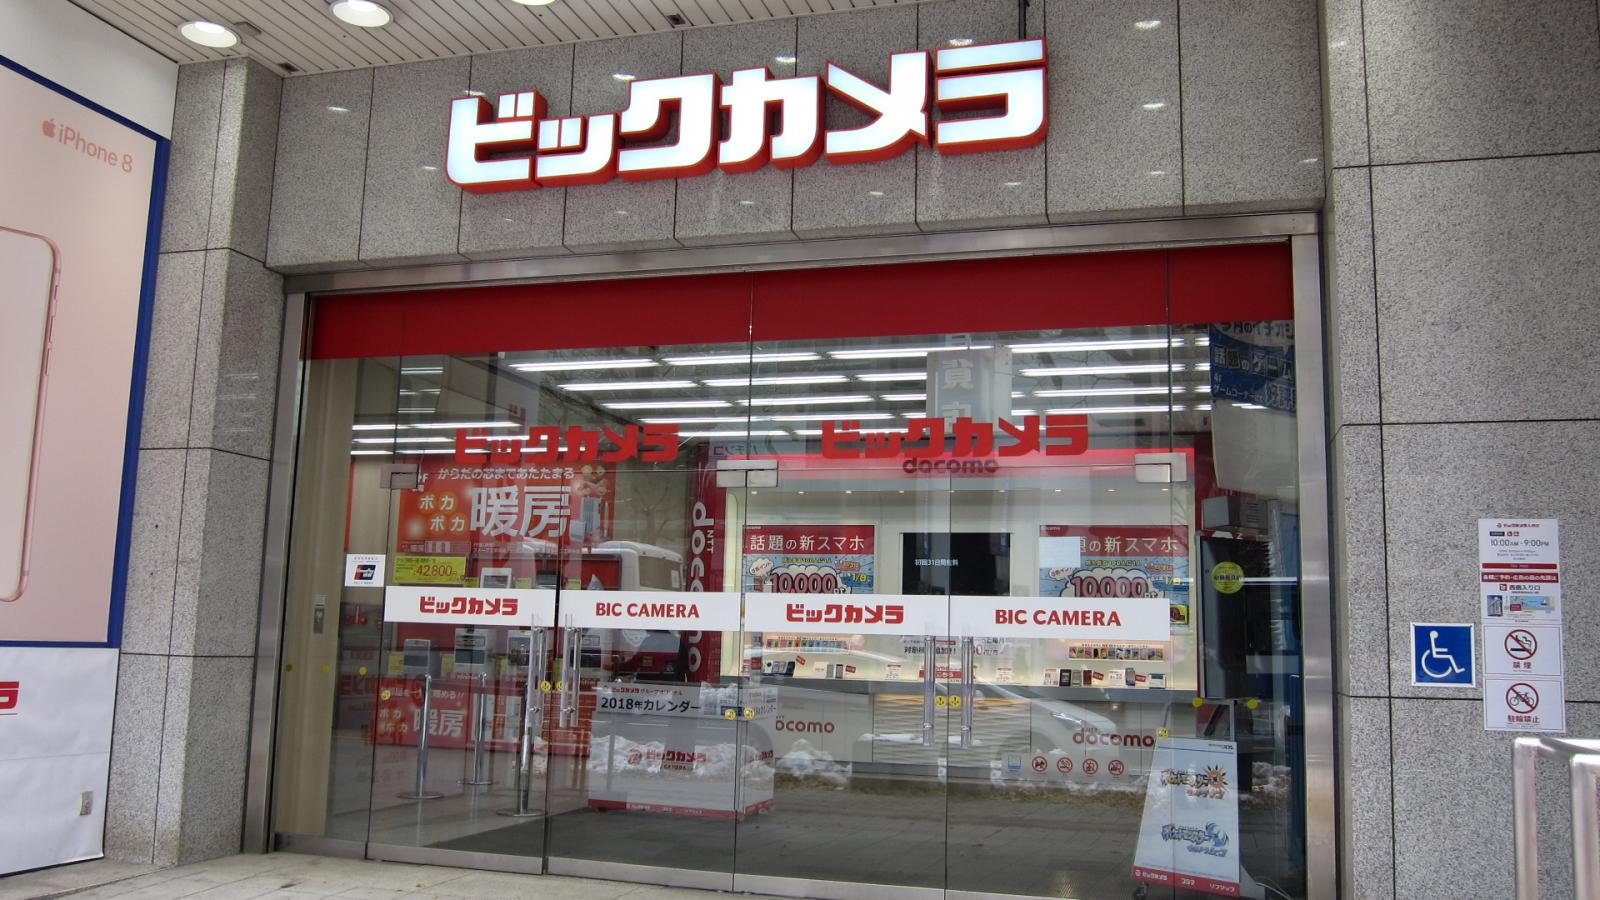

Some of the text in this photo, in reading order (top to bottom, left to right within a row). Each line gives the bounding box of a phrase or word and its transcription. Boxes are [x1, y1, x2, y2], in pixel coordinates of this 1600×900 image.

[445, 38, 1049, 193] ビックカメラ
[59, 124, 133, 173] iPhone 8
[455, 424, 680, 464] ビックカメラ
[821, 414, 1089, 459] ビックカメラ
[438, 467, 575, 480] からだの芯まであたたまる
[903, 458, 998, 473] docomo
[470, 485, 571, 537] 暖房
[750, 535, 865, 551] 話題の新スマホ
[1080, 536, 1177, 553] の新スマホ
[769, 573, 837, 594] 10,000
[419, 596, 518, 616] ビックカメラ
[595, 602, 700, 618] BIC CAMERA
[786, 603, 905, 624] ビックカメラ
[995, 609, 1121, 626] BIC CAMERA
[601, 697, 700, 713] 2018年カレンダー
[1072, 732, 1155, 747] docomo
